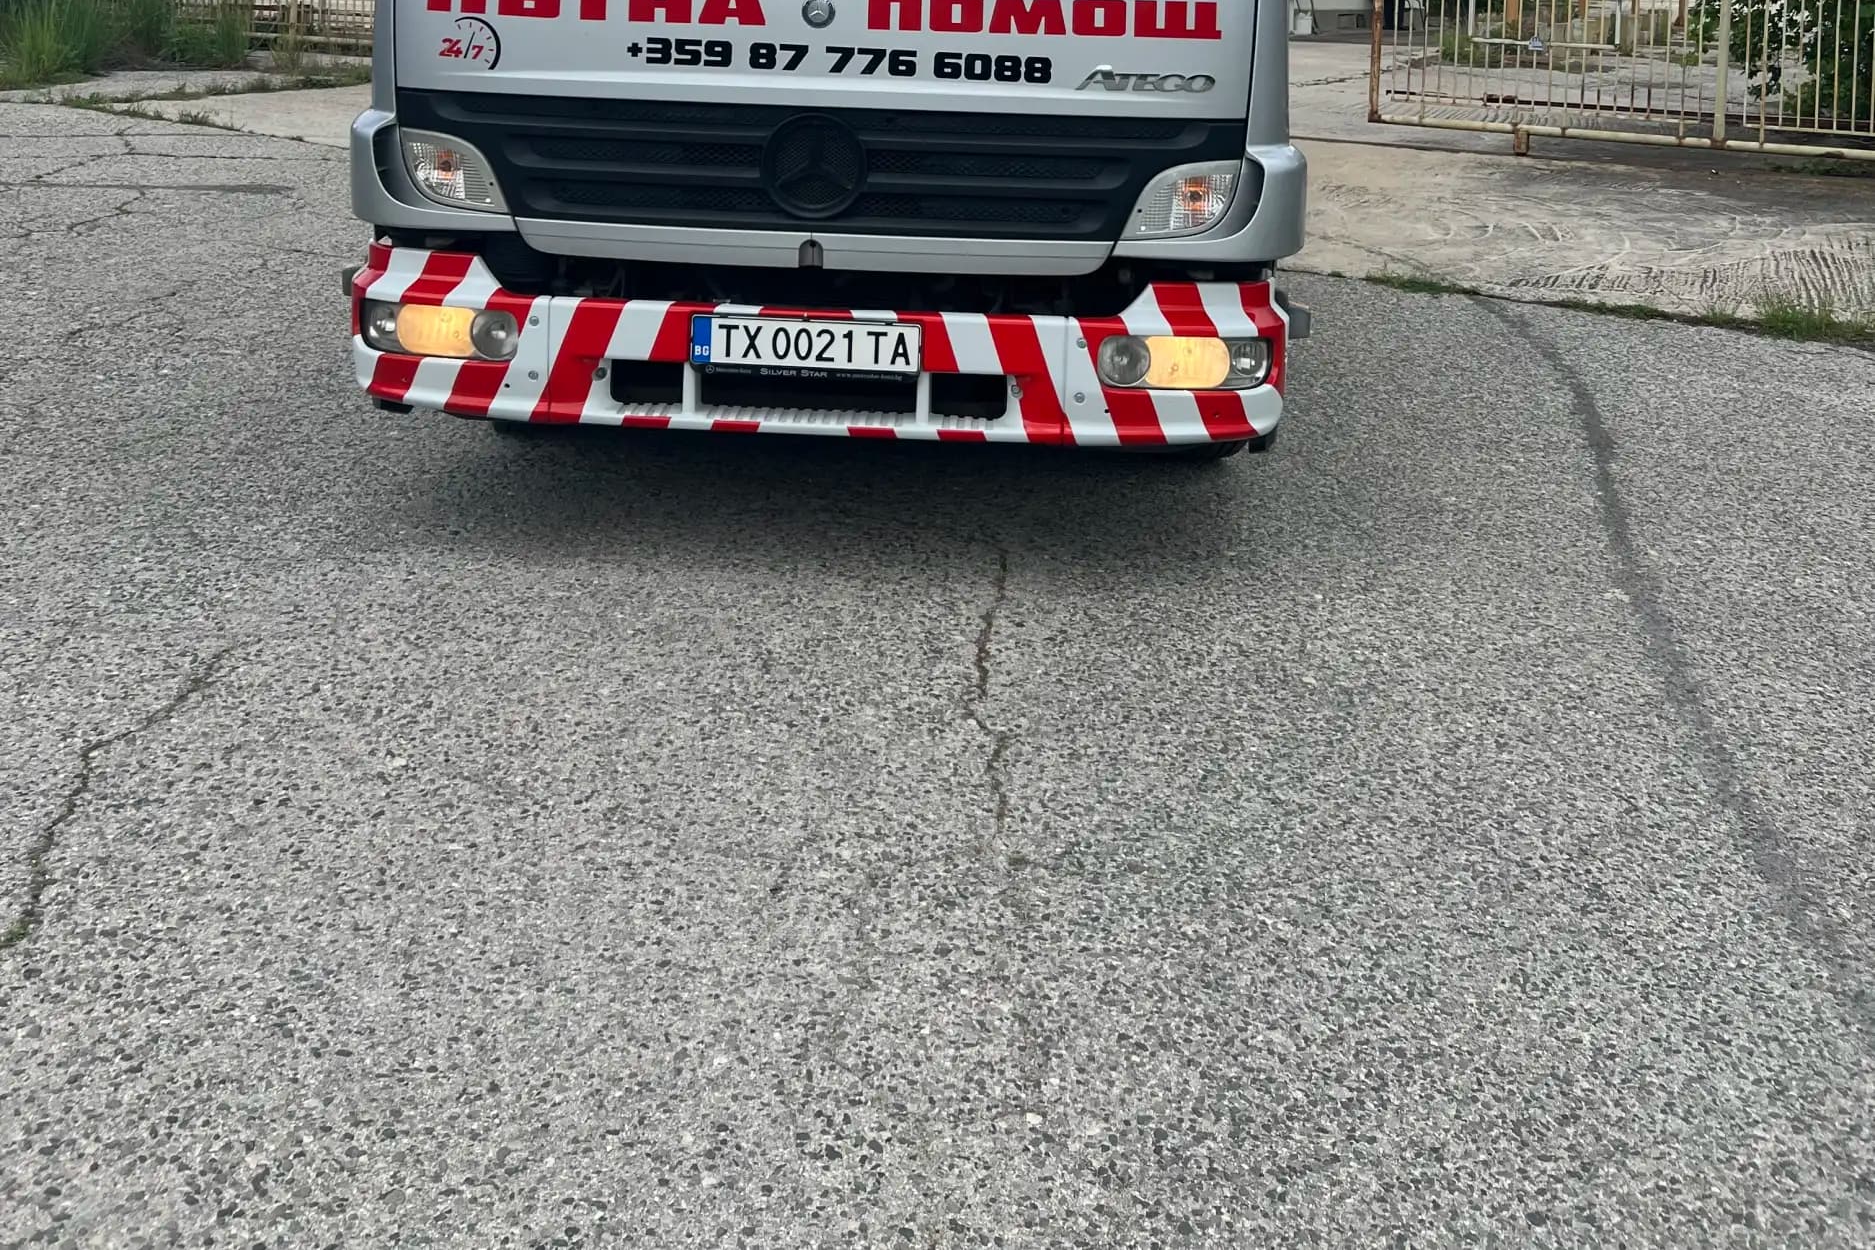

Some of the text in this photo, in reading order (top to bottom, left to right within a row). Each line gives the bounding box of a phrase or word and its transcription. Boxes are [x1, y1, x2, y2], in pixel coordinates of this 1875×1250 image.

[438, 32, 484, 60] 24/7
[626, 36, 1053, 84] +359 87 776 6088
[694, 345, 710, 357] BG
[771, 326, 854, 363] 0021
[867, 331, 911, 366] TA
